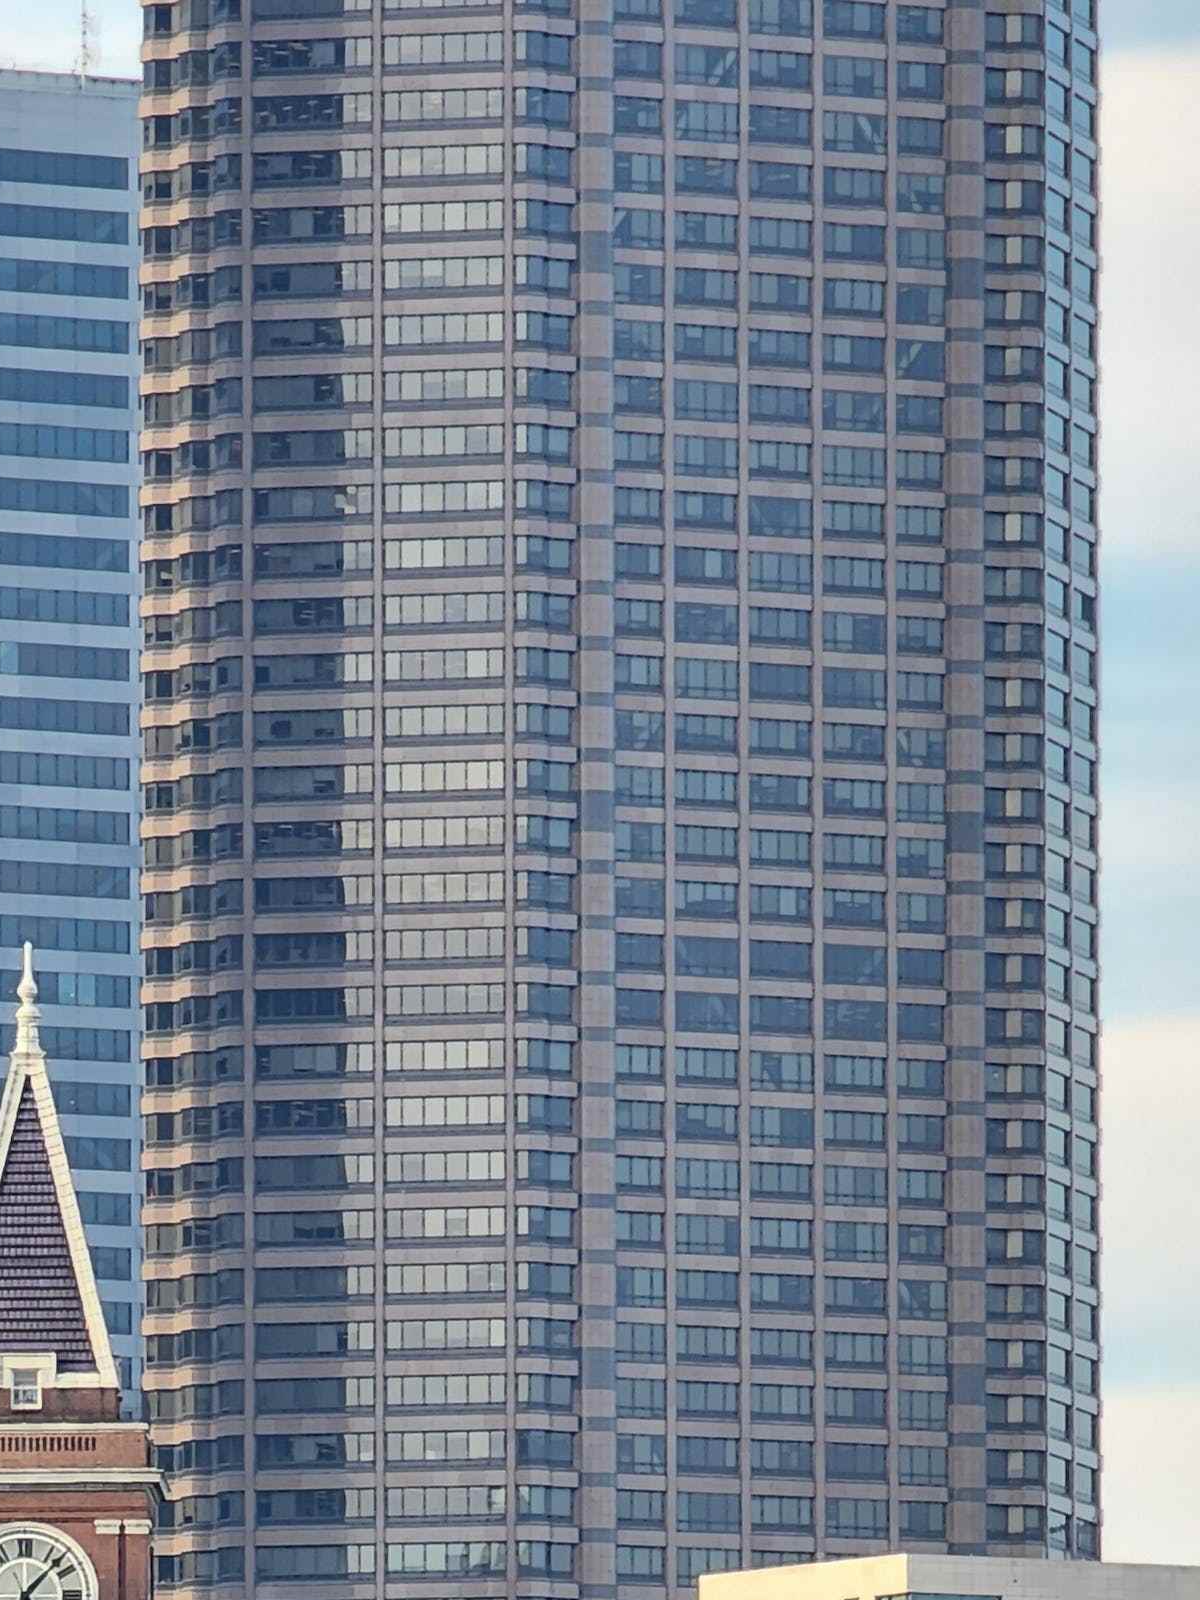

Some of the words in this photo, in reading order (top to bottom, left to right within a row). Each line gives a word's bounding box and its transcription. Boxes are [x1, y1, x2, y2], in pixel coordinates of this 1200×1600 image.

[17, 1538, 33, 1558] XII
[43, 1545, 55, 1563] I
[55, 1563, 77, 1580] II
